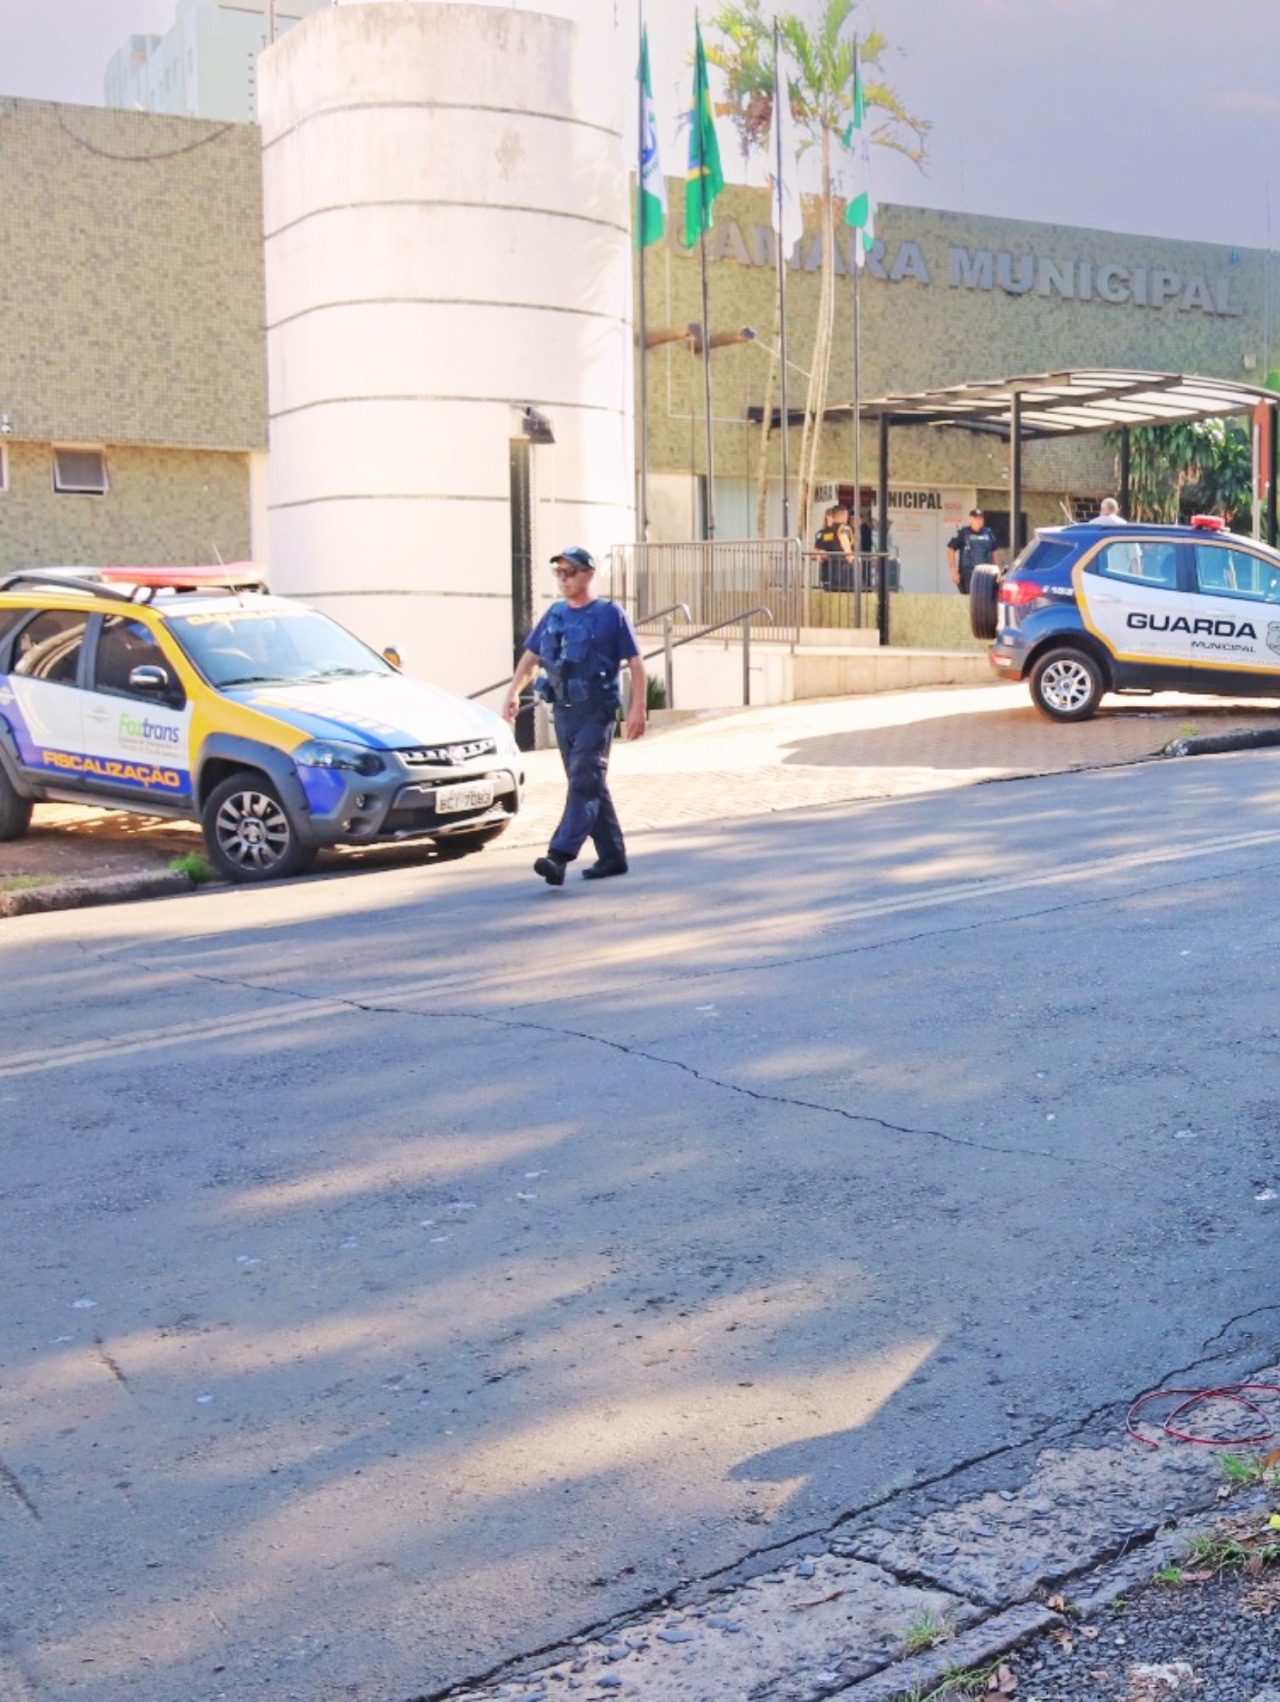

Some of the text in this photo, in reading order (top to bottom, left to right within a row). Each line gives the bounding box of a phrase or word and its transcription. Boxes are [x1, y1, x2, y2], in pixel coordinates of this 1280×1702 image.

[949, 246, 1243, 317] MUNICIPAL
[1126, 613, 1257, 639] GUARDA
[1191, 641, 1256, 653] MUNICIPAL
[43, 750, 181, 788] FISCALIZAÇÃO
